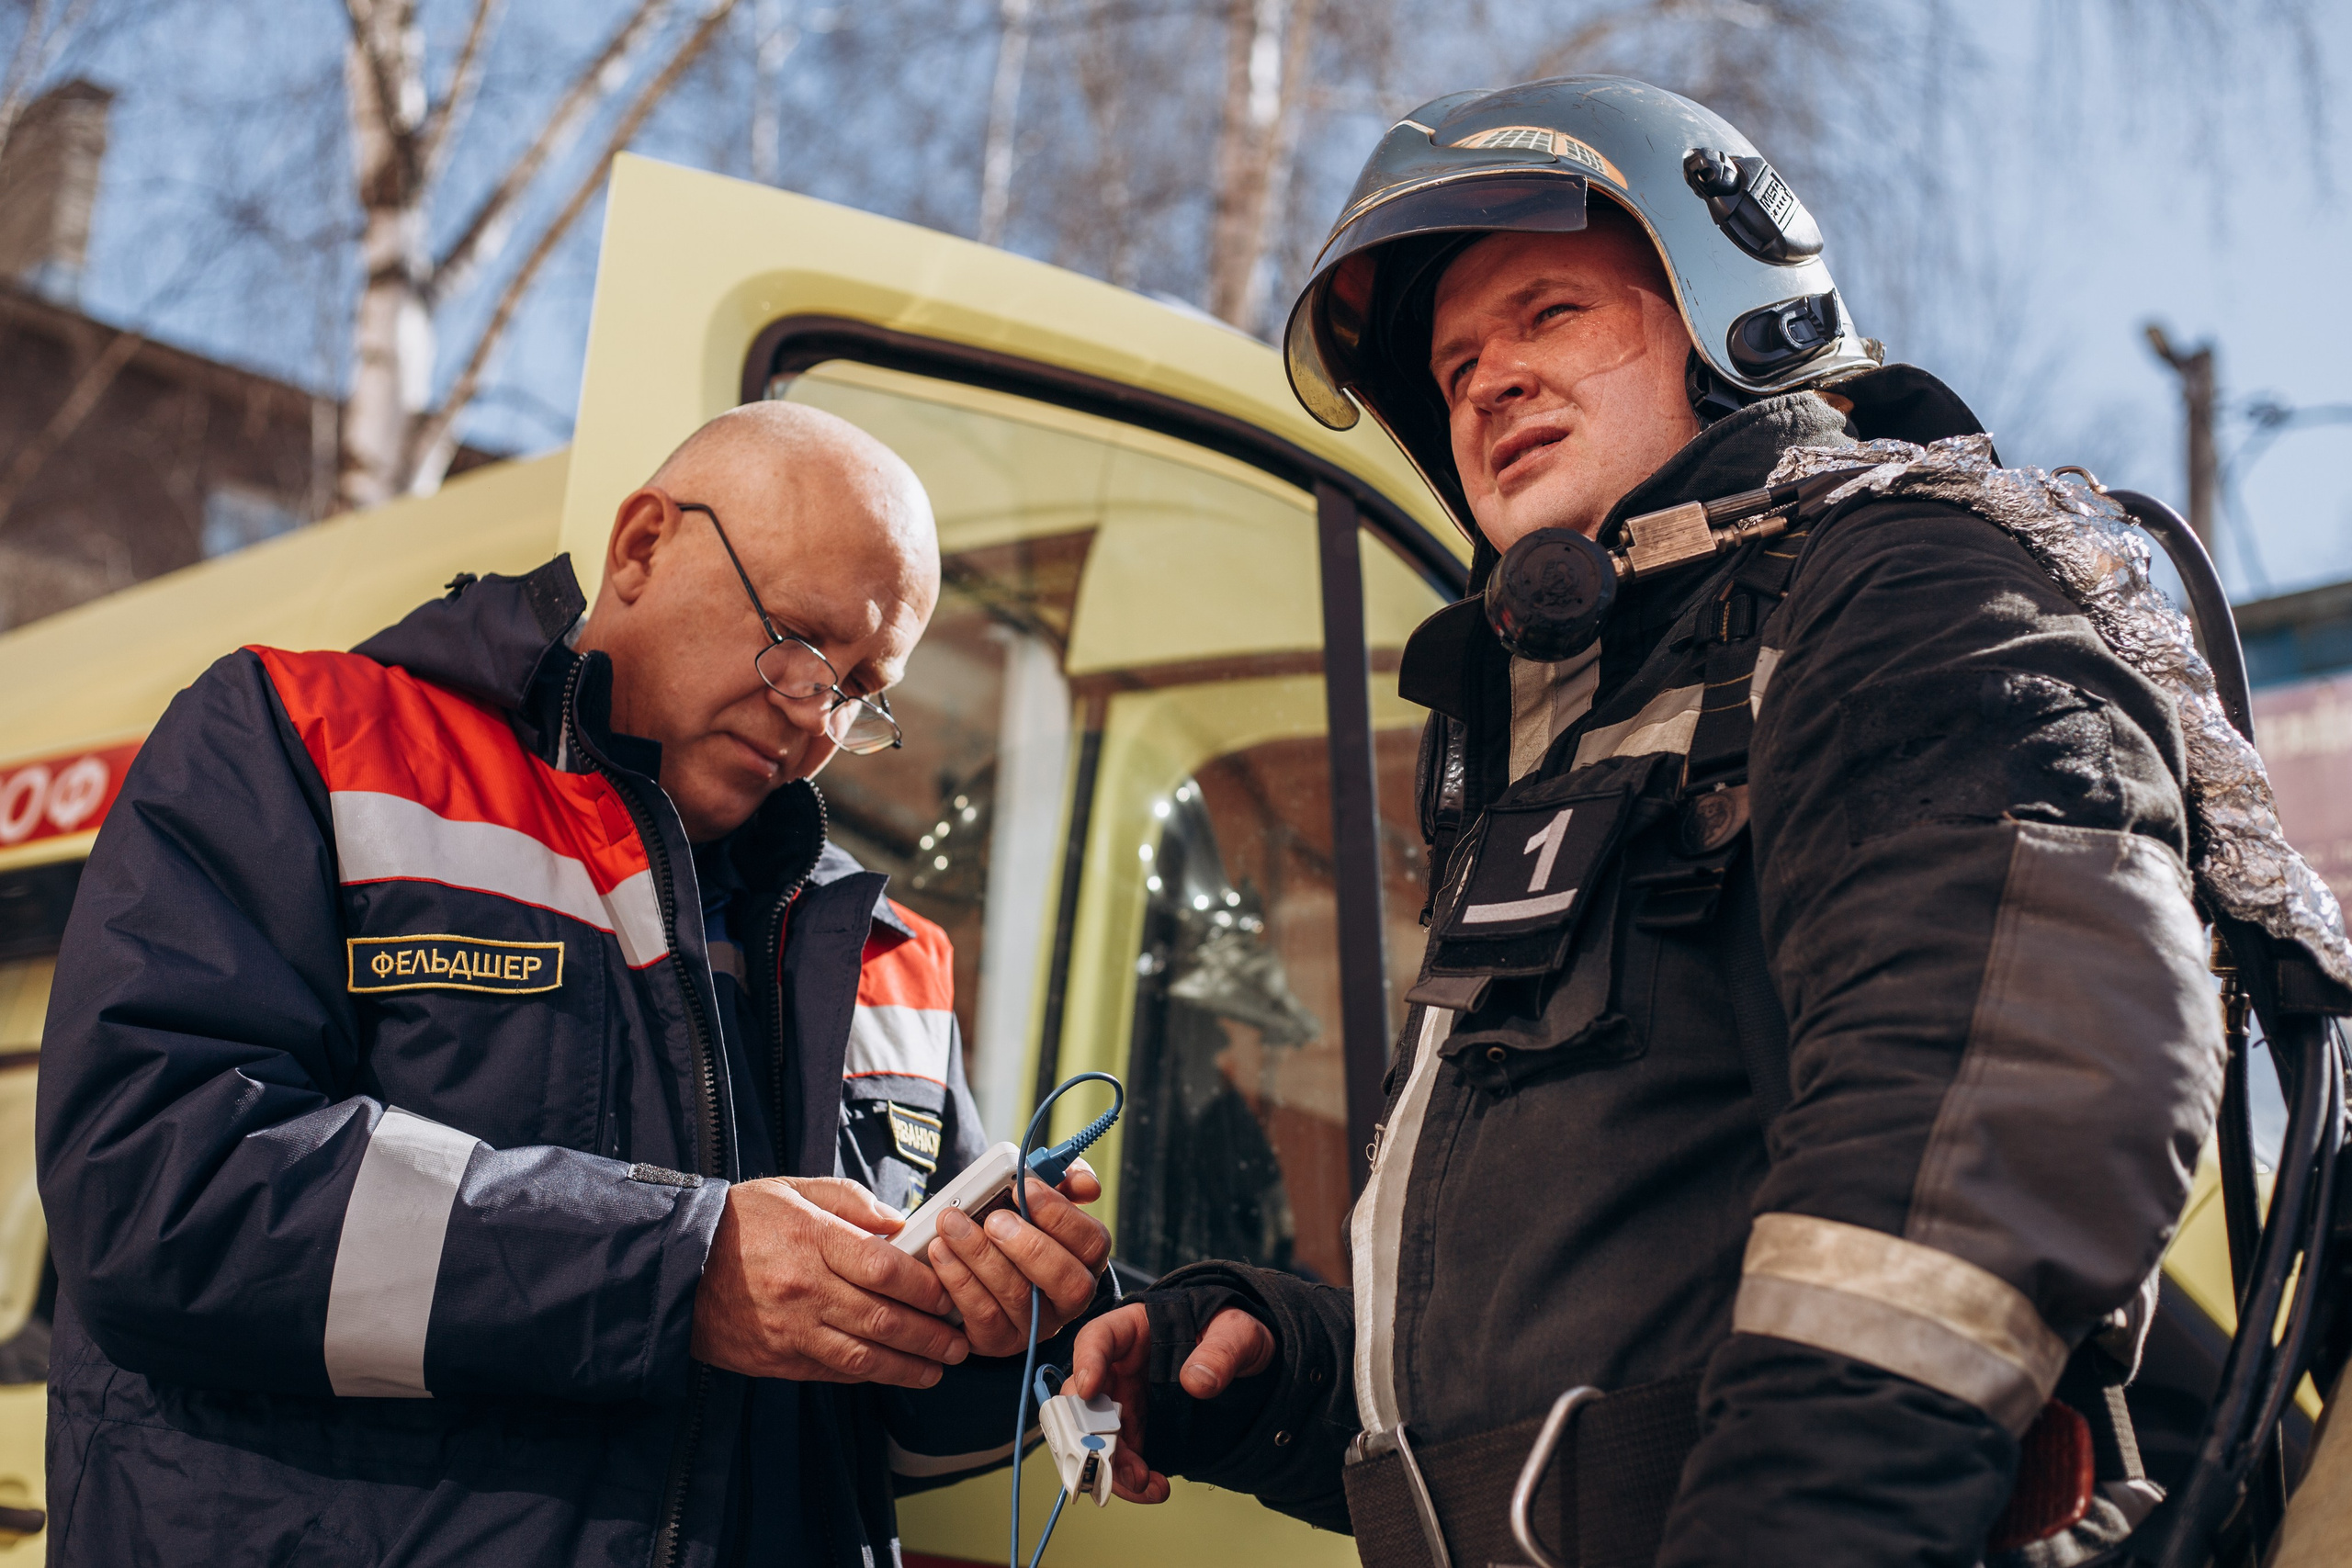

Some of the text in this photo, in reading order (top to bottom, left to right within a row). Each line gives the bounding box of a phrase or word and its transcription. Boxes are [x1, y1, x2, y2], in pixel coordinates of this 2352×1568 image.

[0, 756, 109, 842] ОФ
[1523, 808, 1573, 893] 1
[371, 948, 542, 981] ФЕЛЬДШЕР
